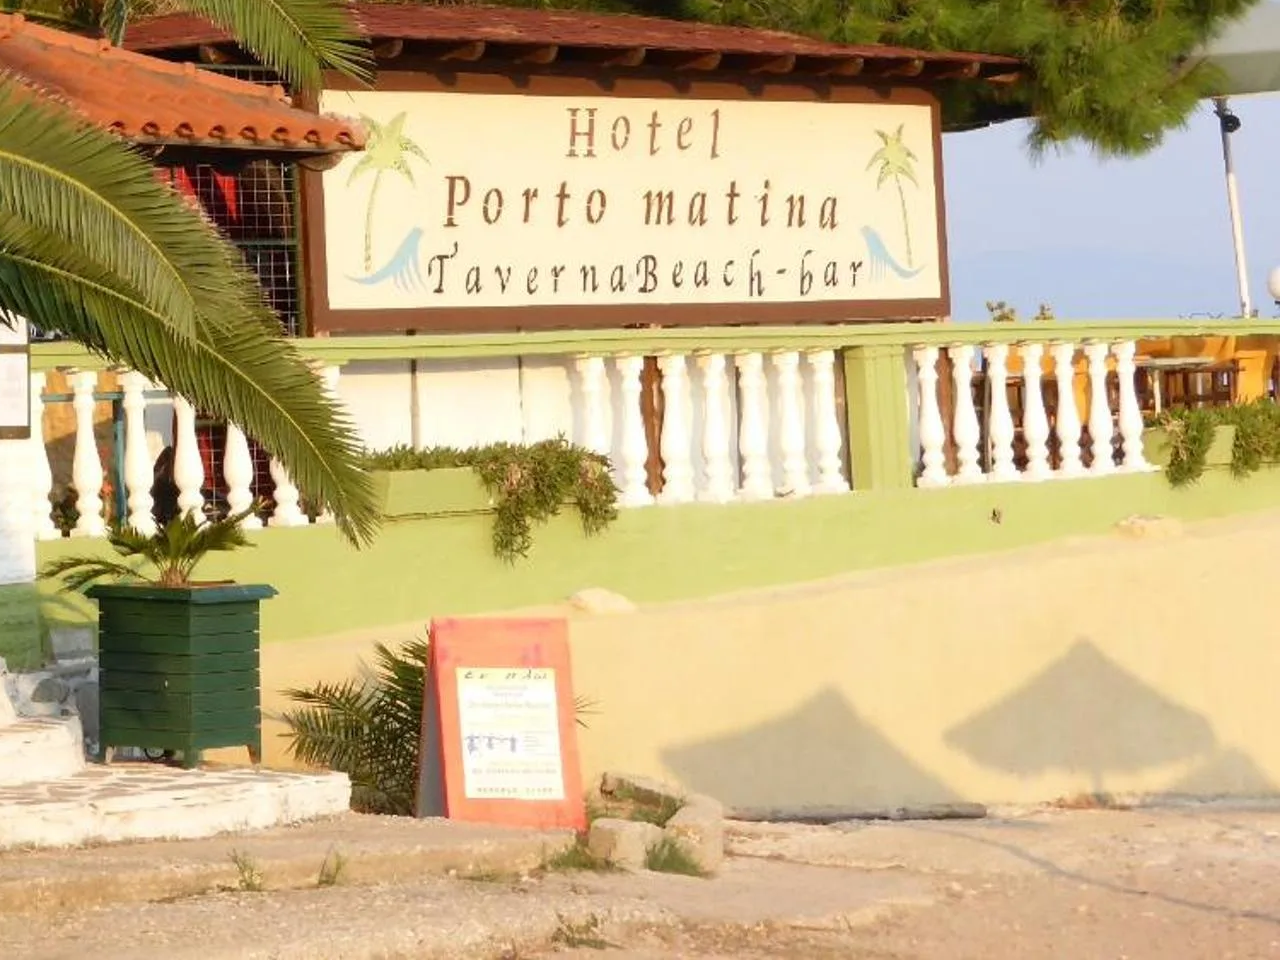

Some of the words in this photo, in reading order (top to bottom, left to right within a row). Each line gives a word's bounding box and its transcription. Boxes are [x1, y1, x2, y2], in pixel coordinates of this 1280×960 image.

[565, 107, 722, 159] Hotel
[443, 175, 608, 228] Porto
[643, 179, 838, 230] matina
[427, 242, 628, 295] Taverna
